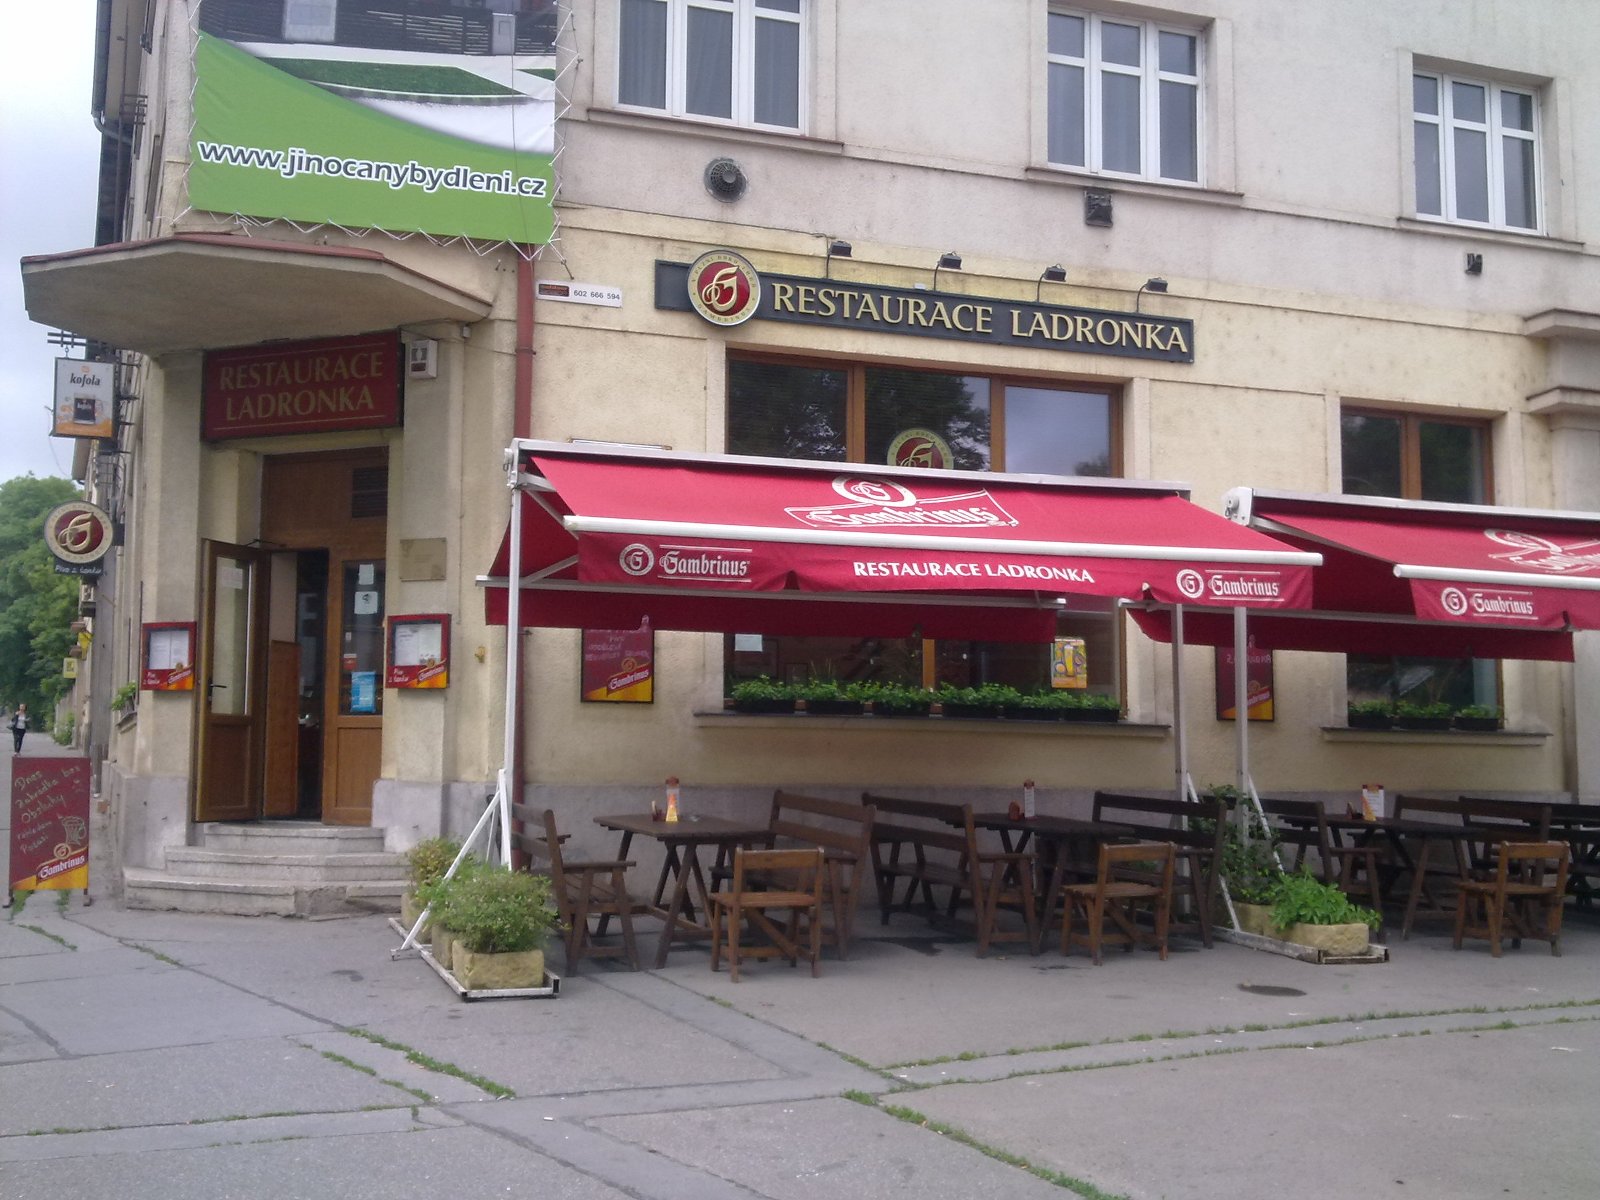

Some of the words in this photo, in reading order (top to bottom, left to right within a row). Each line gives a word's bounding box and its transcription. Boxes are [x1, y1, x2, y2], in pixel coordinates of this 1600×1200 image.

[198, 138, 546, 197] www.jinocanybydleni.cz
[573, 289, 588, 298] 602
[590, 291, 604, 299] 666
[772, 283, 993, 333] RESTAURACE
[1010, 309, 1188, 353] LADRONKA
[70, 373, 101, 387] kofola
[219, 351, 384, 391] RESTAURACE
[226, 385, 375, 421] LADRONKA
[806, 507, 1001, 526] Gambrinus
[659, 550, 748, 576] Gambrinus
[853, 562, 981, 577] RESTAURACE
[985, 563, 1095, 584] LADRONKA
[1208, 575, 1279, 596] Gambrinus
[1470, 593, 1532, 614] Gambrinus
[38, 855, 85, 879] Gambrinus
